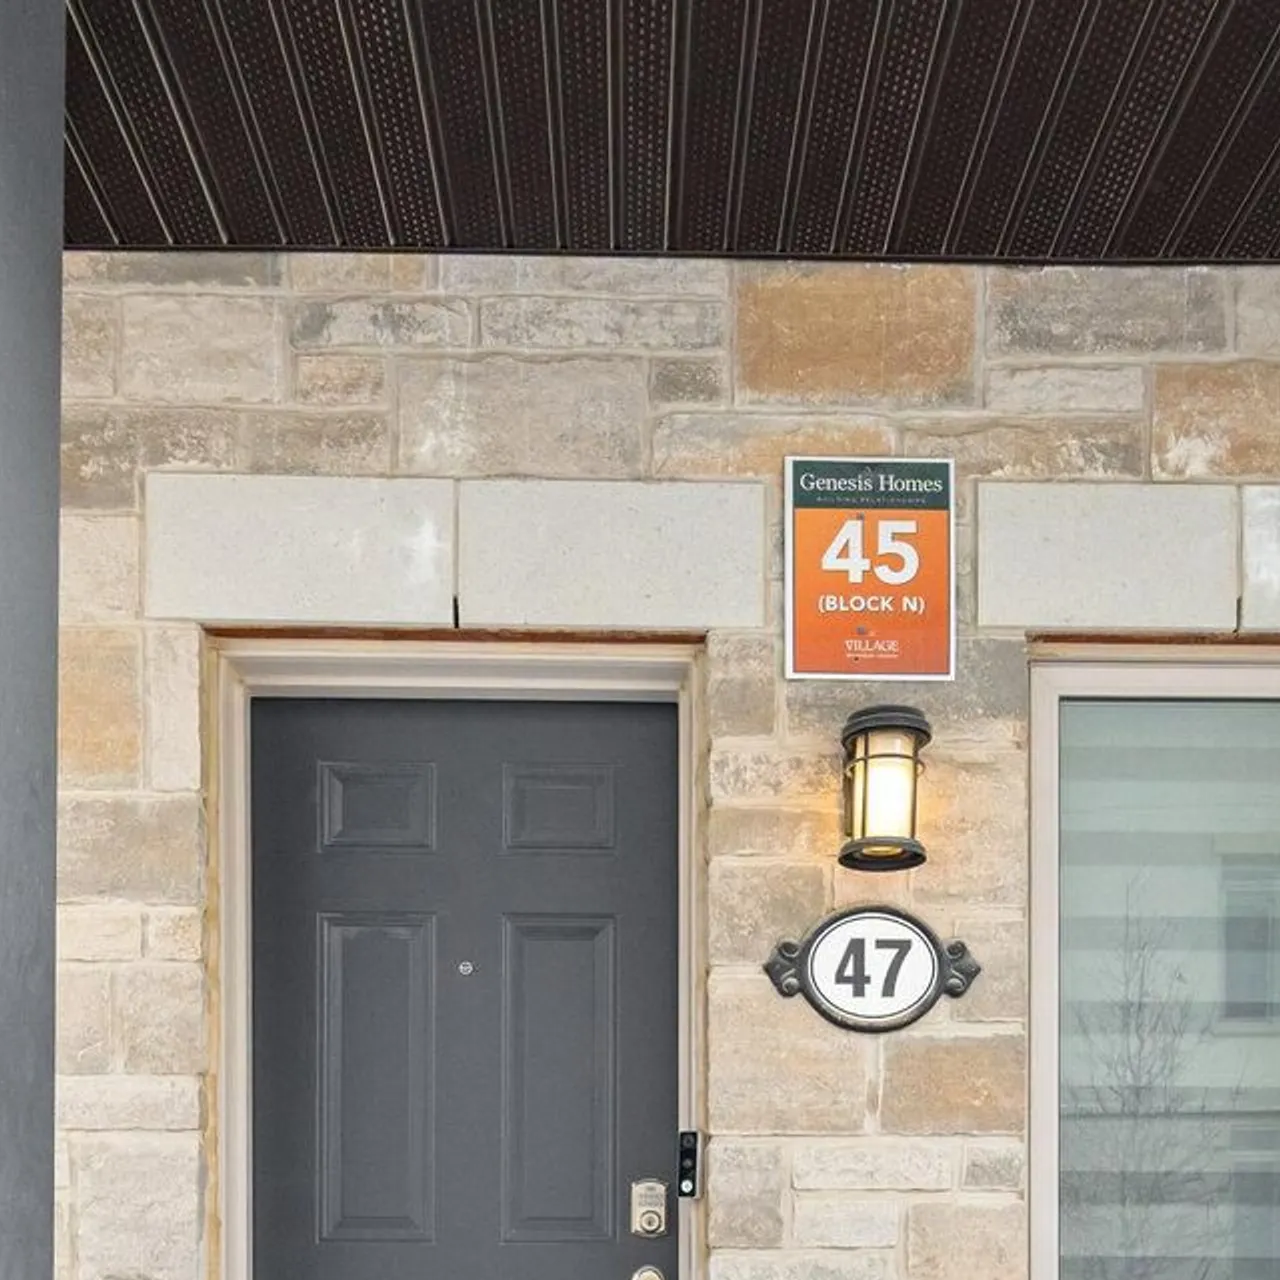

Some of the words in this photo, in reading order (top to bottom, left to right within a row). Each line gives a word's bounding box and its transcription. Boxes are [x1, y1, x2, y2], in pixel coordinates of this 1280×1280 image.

[799, 473, 874, 492] Genesis
[877, 474, 944, 493] Homes
[821, 518, 920, 586] 45
[818, 595, 894, 614] (BLOCK
[901, 596, 926, 615] N)
[843, 639, 900, 652] VILLAGE
[833, 937, 913, 999] 47
